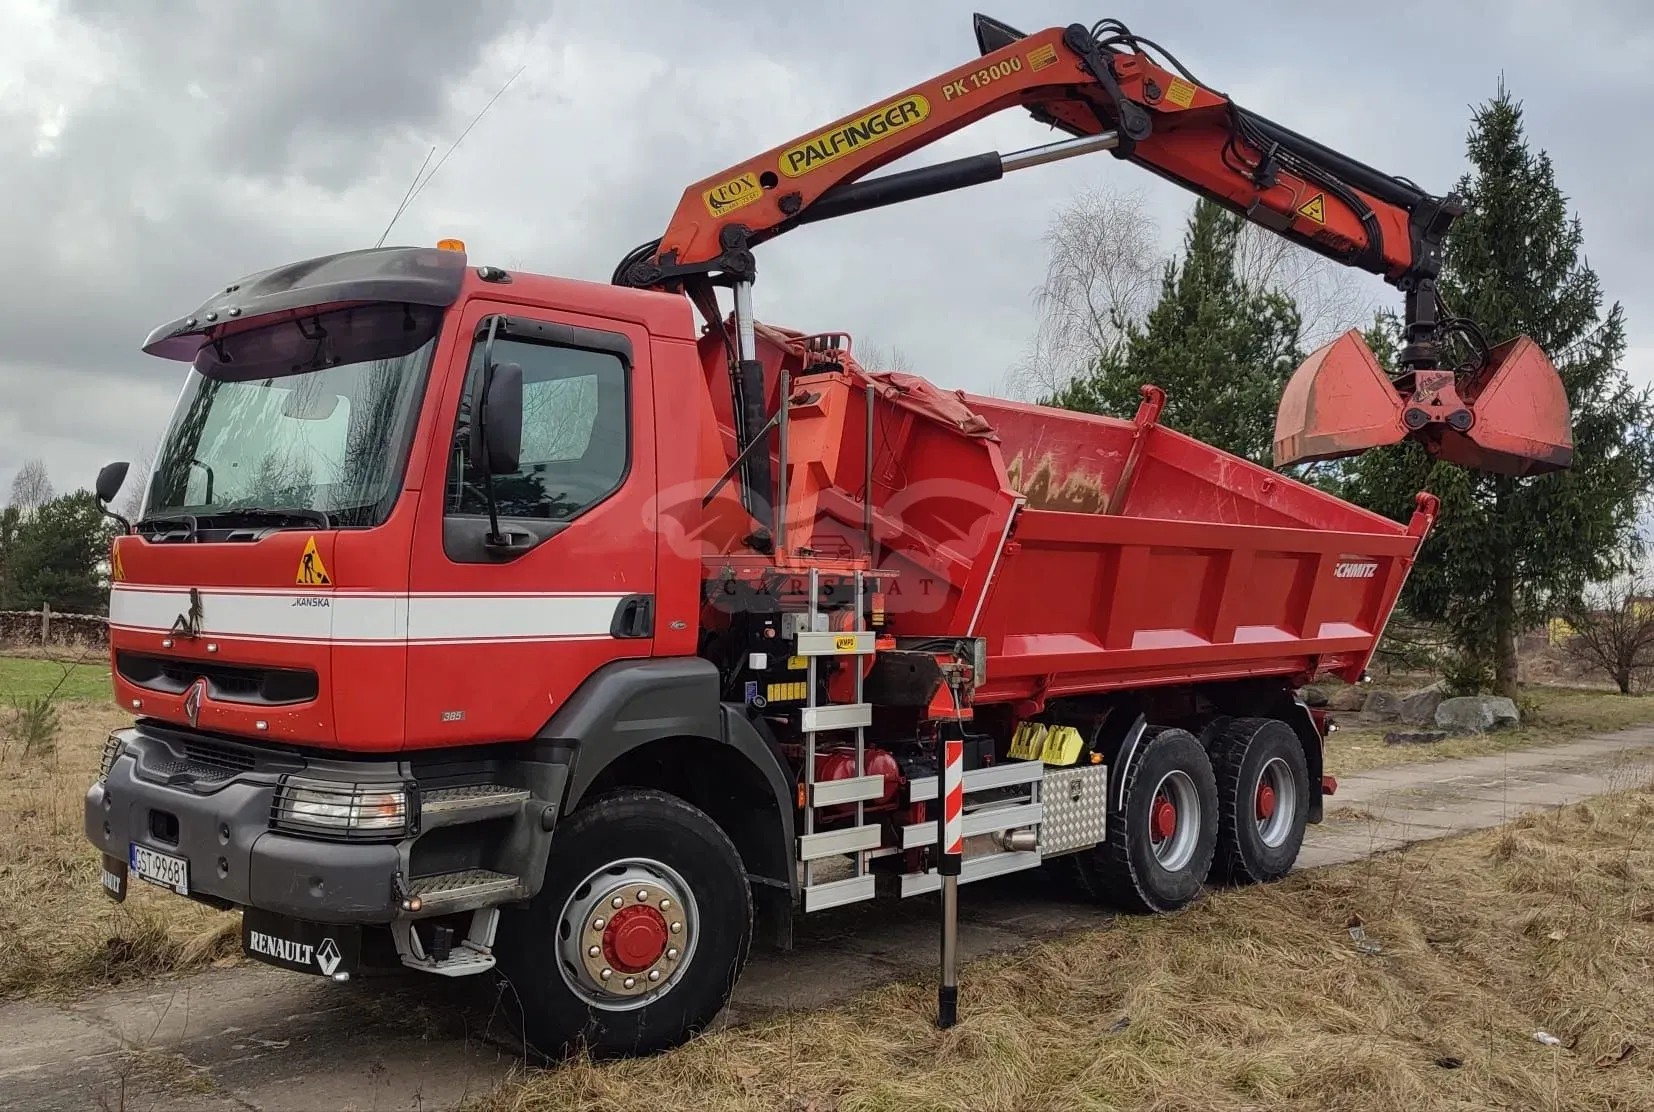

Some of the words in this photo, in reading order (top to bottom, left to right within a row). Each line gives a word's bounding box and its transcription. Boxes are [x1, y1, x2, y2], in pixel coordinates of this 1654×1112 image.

[942, 80, 970, 101] PK
[970, 57, 1023, 89] 13000
[787, 100, 921, 172] PALFINGER
[717, 175, 755, 201] FOX
[443, 711, 462, 721] 385
[135, 849, 152, 876] GST
[155, 855, 186, 886] 99681
[250, 930, 314, 965] RENAULT
